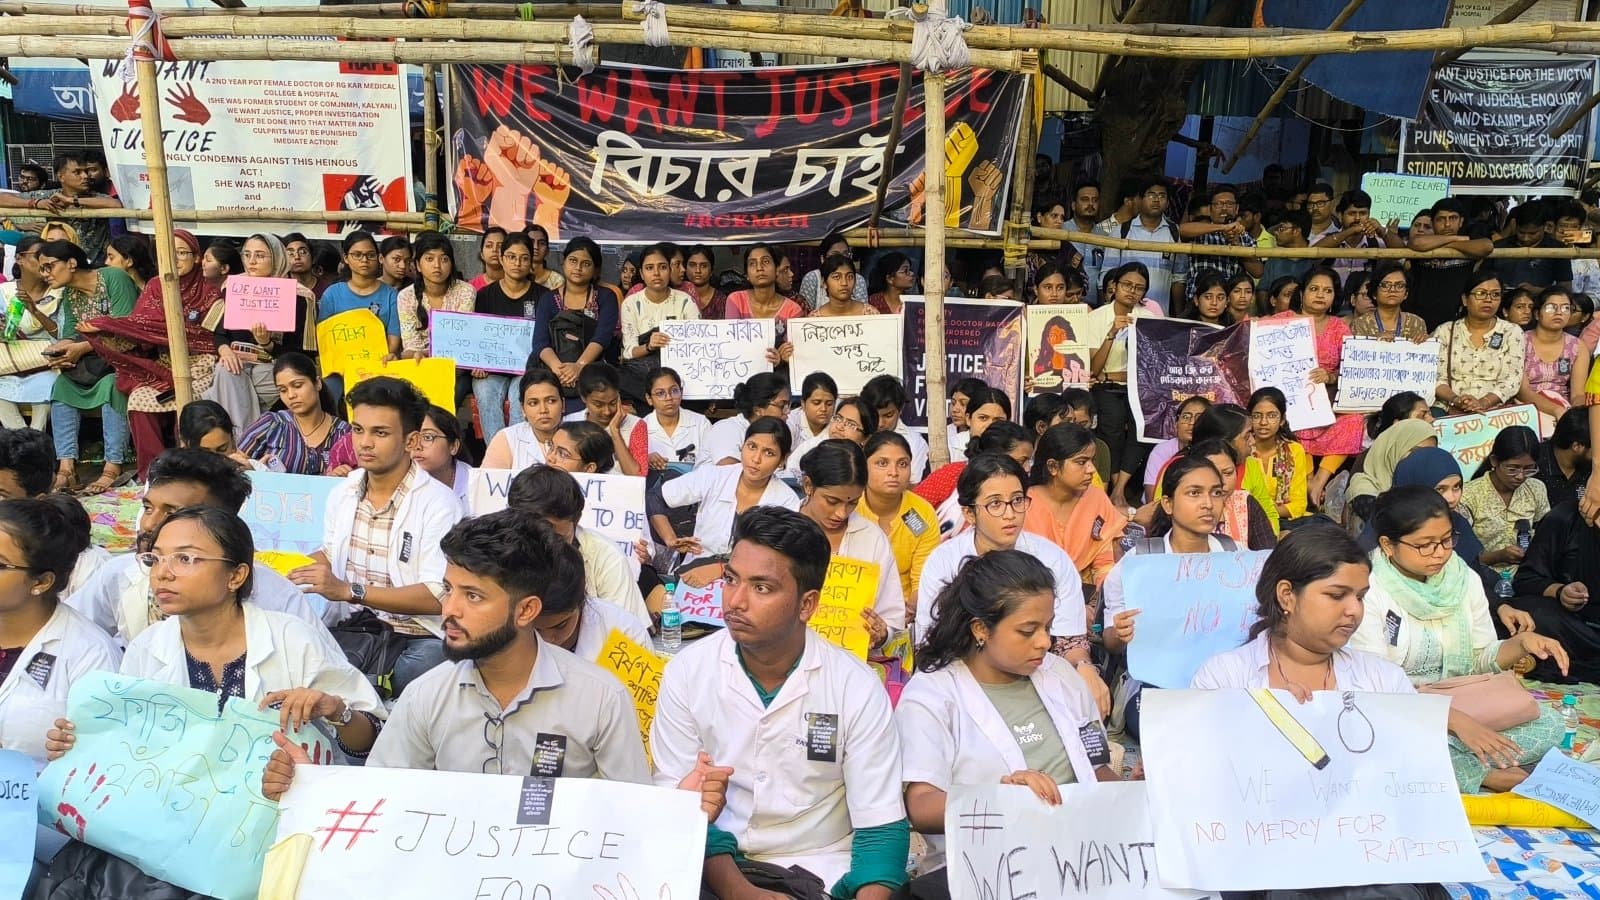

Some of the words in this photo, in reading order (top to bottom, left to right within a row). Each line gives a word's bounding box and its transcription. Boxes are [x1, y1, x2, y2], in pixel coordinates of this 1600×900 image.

[1463, 69, 1507, 80] JUSTICE
[1510, 69, 1531, 80] FOR
[1534, 69, 1554, 80] THE
[1556, 68, 1593, 80] VICTIM
[264, 89, 297, 97] COLLEGE
[1431, 89, 1441, 103] E
[1443, 90, 1474, 106] WANT
[1477, 94, 1530, 107] JUDICIAL
[1531, 92, 1582, 107] ENQUIRY
[473, 66, 552, 121] WE
[579, 68, 739, 136] WANT
[262, 108, 294, 116] JUSTICE,
[295, 109, 324, 117] PROPER
[324, 110, 380, 119] INVESTIGATION
[1453, 111, 1481, 126] AND
[1483, 112, 1552, 128] EXAMPLARY
[256, 117, 267, 125] BE
[308, 119, 328, 127] THAT
[328, 120, 358, 128] MATTER
[252, 127, 288, 136] CULPRITS
[288, 128, 310, 136] MUST
[320, 129, 359, 137] PUNISHED
[110, 128, 217, 152] JUTICE
[274, 137, 309, 145] IMEDIATE
[1495, 134, 1509, 147] OF
[1514, 134, 1537, 148] THE
[193, 154, 249, 165] CONDEMNS
[249, 156, 291, 166] AGAINST
[292, 157, 312, 166] THIS
[313, 158, 359, 168] HEINOUS
[590, 130, 773, 202] বিচার
[785, 133, 906, 200] চাই
[240, 168, 259, 177] ACT
[1407, 161, 1465, 178] STUDENTS
[1465, 161, 1488, 178] AND
[1488, 162, 1534, 179] DOCTORS
[1535, 163, 1549, 179] OF
[214, 179, 233, 189] SHE
[234, 180, 256, 189] WAS
[257, 180, 291, 190] RAPED!
[1369, 178, 1406, 190] JUSTICE
[1410, 180, 1448, 191] DELAYED
[244, 193, 262, 202] and
[1373, 195, 1384, 204] IS
[1385, 194, 1421, 206] JUSTICE
[1380, 209, 1415, 222] DENIED
[231, 282, 251, 297] WE
[252, 285, 282, 298] WANT
[238, 297, 280, 310] JUSTICE
[950, 320, 983, 328] DOCTOR
[944, 329, 982, 338] URDERED
[961, 339, 980, 347] MCH
[916, 352, 985, 374] JTICE
[591, 508, 615, 527] TO
[623, 511, 644, 530] BE
[1176, 555, 1212, 583] NO
[683, 591, 714, 606] FOR
[1184, 600, 1222, 635] NO
[1228, 755, 1275, 808] WE
[1307, 769, 1361, 804] WANT
[1384, 770, 1449, 798] JUSTICE
[395, 809, 626, 860] JUSTICE
[1193, 821, 1227, 848] NO
[1245, 817, 1322, 847] MERCY
[1336, 813, 1388, 836] FOR
[1357, 839, 1463, 864] RAPIST
[962, 846, 1037, 900] WE
[1050, 840, 1154, 897] WANT
